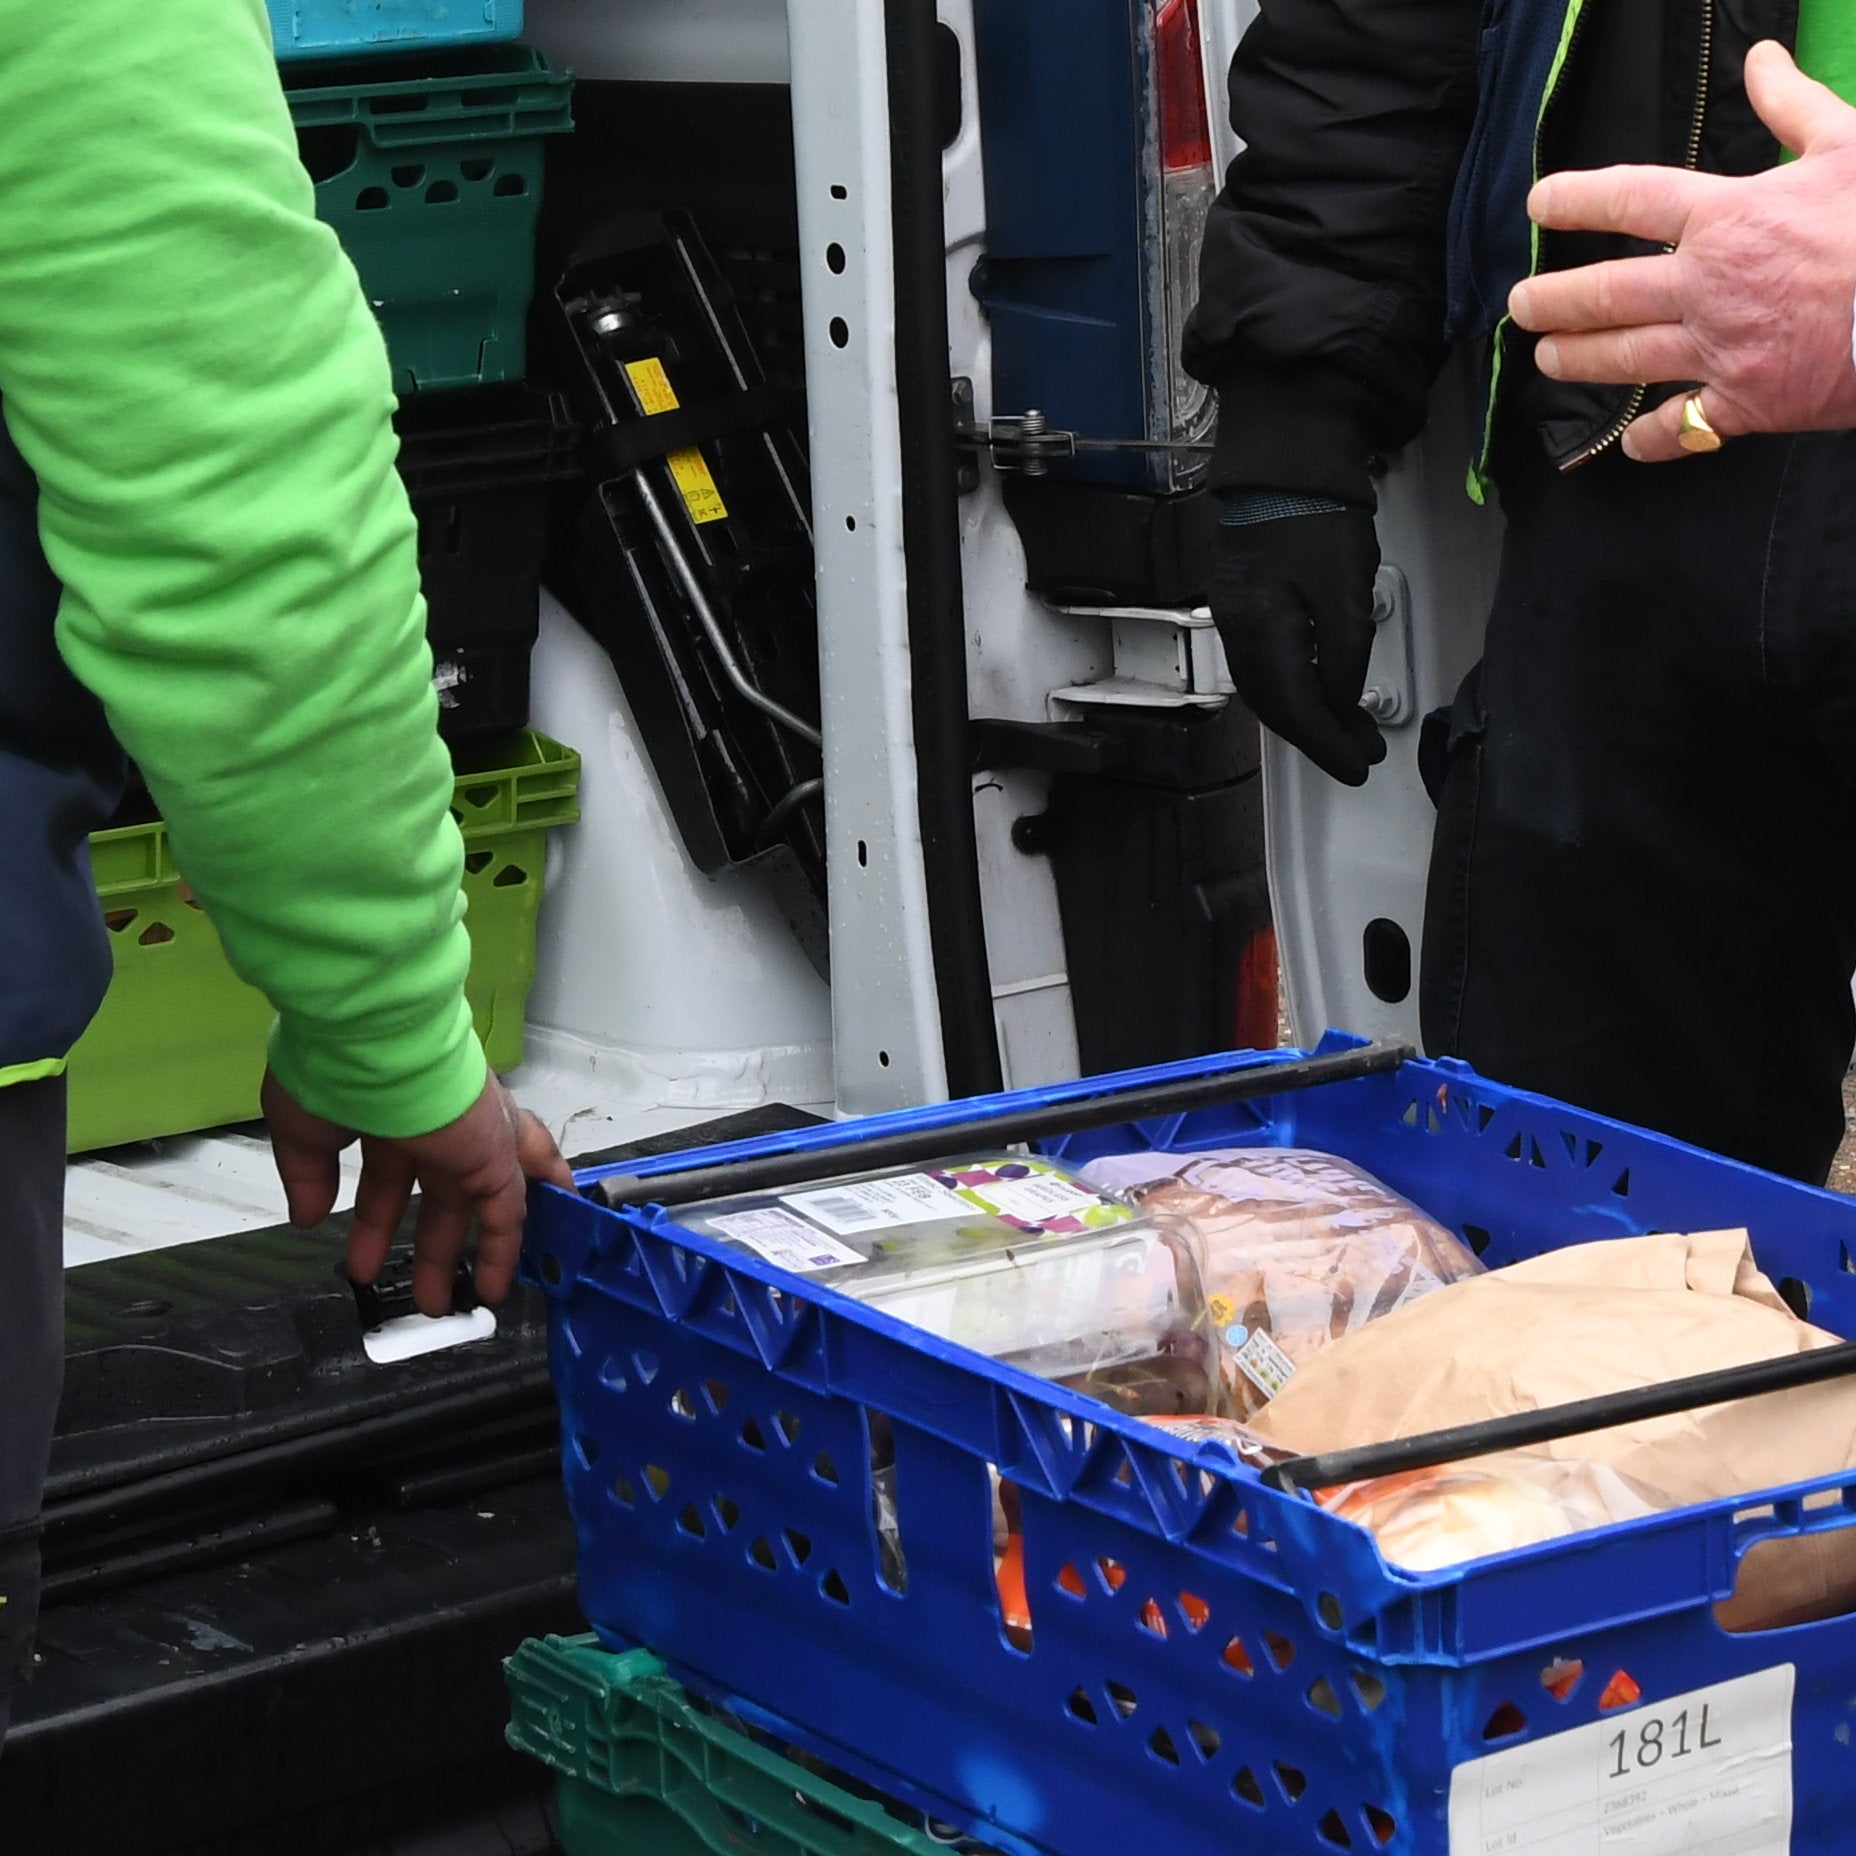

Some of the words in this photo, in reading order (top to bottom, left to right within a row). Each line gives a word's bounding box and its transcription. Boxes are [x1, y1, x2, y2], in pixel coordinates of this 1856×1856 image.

[1608, 1703, 1722, 1778] 181L
[1485, 1784, 1502, 1798] Lot
[1485, 1838, 1503, 1853] Lot
